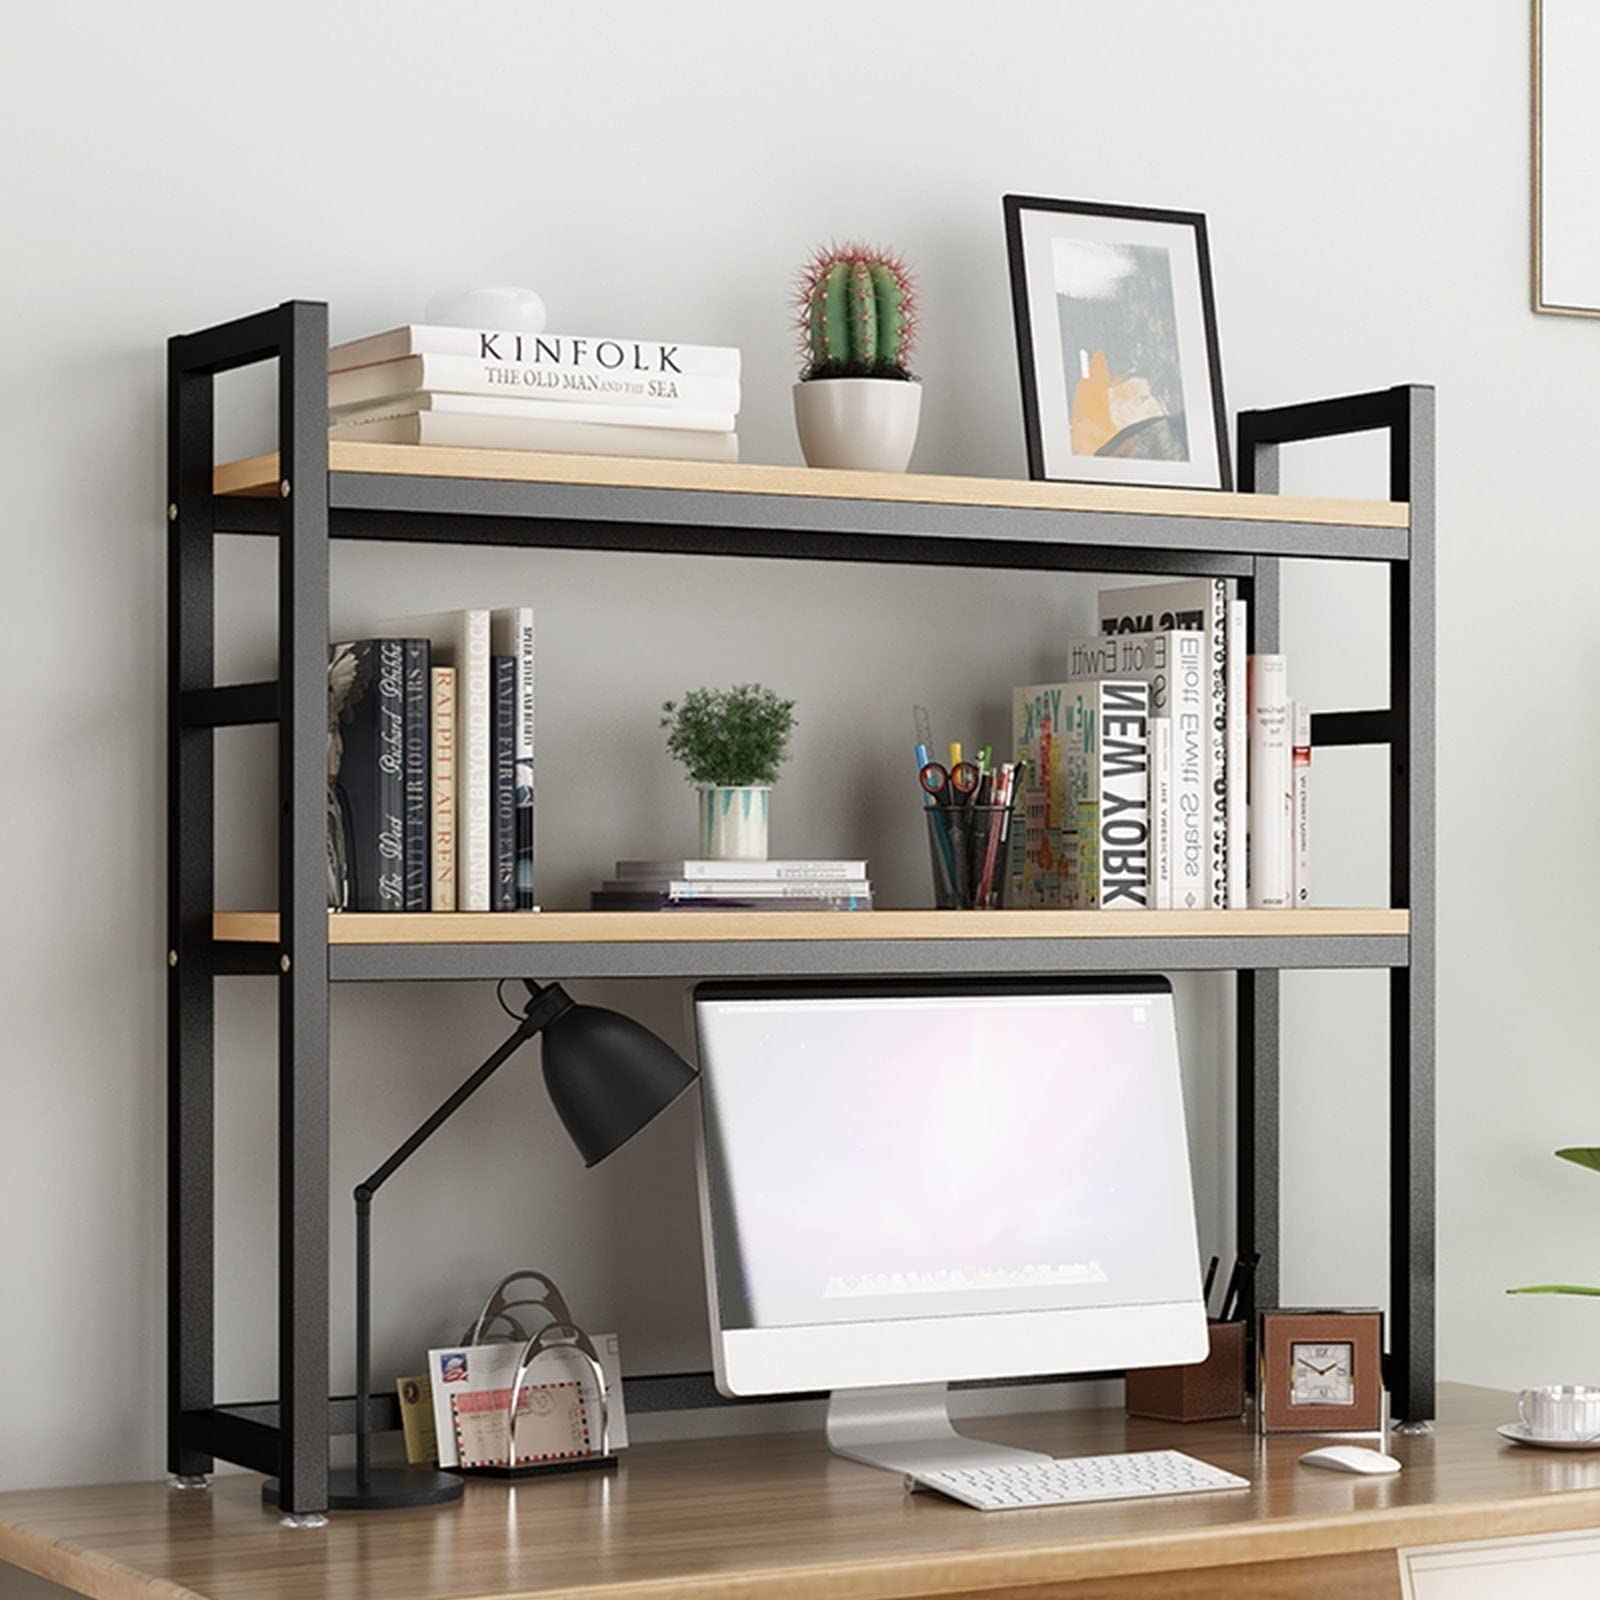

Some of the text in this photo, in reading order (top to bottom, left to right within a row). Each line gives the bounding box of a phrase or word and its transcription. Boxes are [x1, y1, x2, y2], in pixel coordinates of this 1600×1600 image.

[479, 332, 682, 374] KINFOLK
[484, 366, 679, 399] THE OLD MAN AND THE SEA
[379, 704, 403, 781] Richard
[407, 669, 424, 907] VANITY FAIR 100 YEARS
[436, 672, 453, 883] RALPH LAUREN
[469, 611, 488, 908] PAINTING BEYOND POLLOCK
[499, 660, 514, 884] VANITY FAIR 100 YEARS
[379, 872, 403, 908] The
